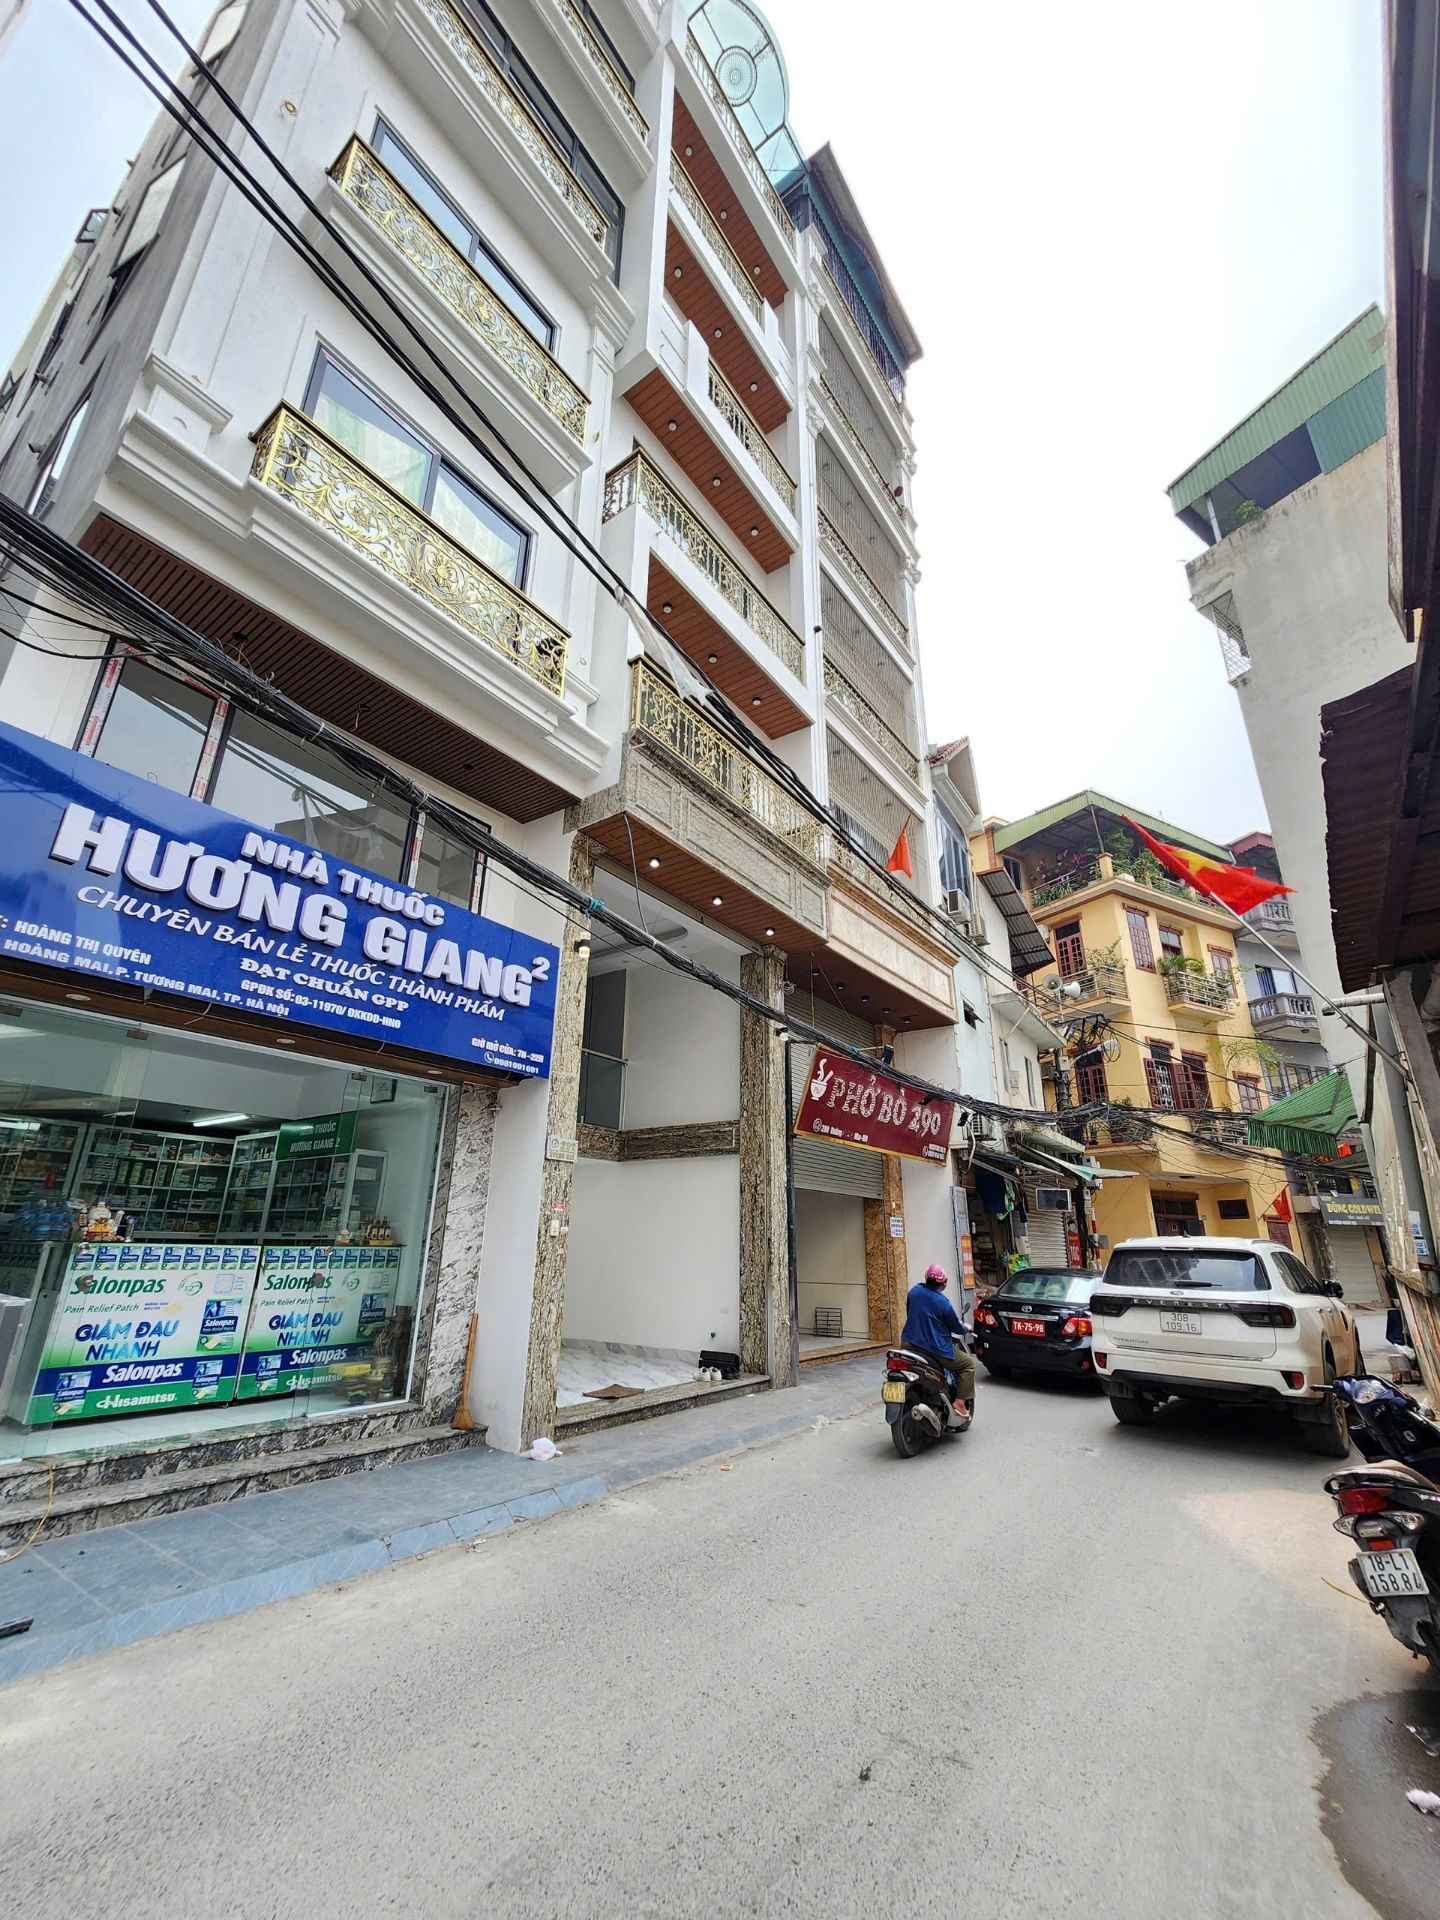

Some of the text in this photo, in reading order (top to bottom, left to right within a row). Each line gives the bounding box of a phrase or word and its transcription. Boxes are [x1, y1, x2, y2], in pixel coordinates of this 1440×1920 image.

[241, 832, 445, 927] NHÀ THUỐC
[50, 802, 348, 947] HƯƠNG
[363, 916, 533, 1007] GIANG
[14, 920, 73, 945] HOÀNG
[76, 935, 100, 954] THỊ
[102, 943, 152, 965] QUYÊN
[77, 886, 505, 1021] CHUYÊN BÁN LẺ THUỐC THÀNH PHẨM
[4, 939, 70, 963] HOÀNG
[134, 970, 185, 991] TƯƠNG
[223, 992, 243, 1006] TP.
[246, 998, 265, 1010] HÀ
[266, 1003, 290, 1016] NỘI
[240, 957, 409, 1012] ĐẠT CHUẨN GPP
[827, 1075, 881, 1118] PHỞ
[878, 1088, 907, 1126] BÒ
[908, 1105, 942, 1137] 290
[64, 1305, 85, 1314] Pain
[87, 1303, 114, 1313] Relief
[115, 1303, 140, 1312] Patch
[1133, 1299, 1225, 1309] EVEREST
[75, 1318, 180, 1342] GIẢM ĐAU
[269, 1311, 344, 1331] GIẢM ĐAU
[1012, 1321, 1045, 1333] TK-75-98
[277, 1329, 331, 1347] NHANH
[85, 1340, 161, 1362] NHANH
[289, 1348, 348, 1365] Salonpas
[102, 1362, 184, 1383] Salonpas
[1367, 1552, 1410, 1573] 18-L1
